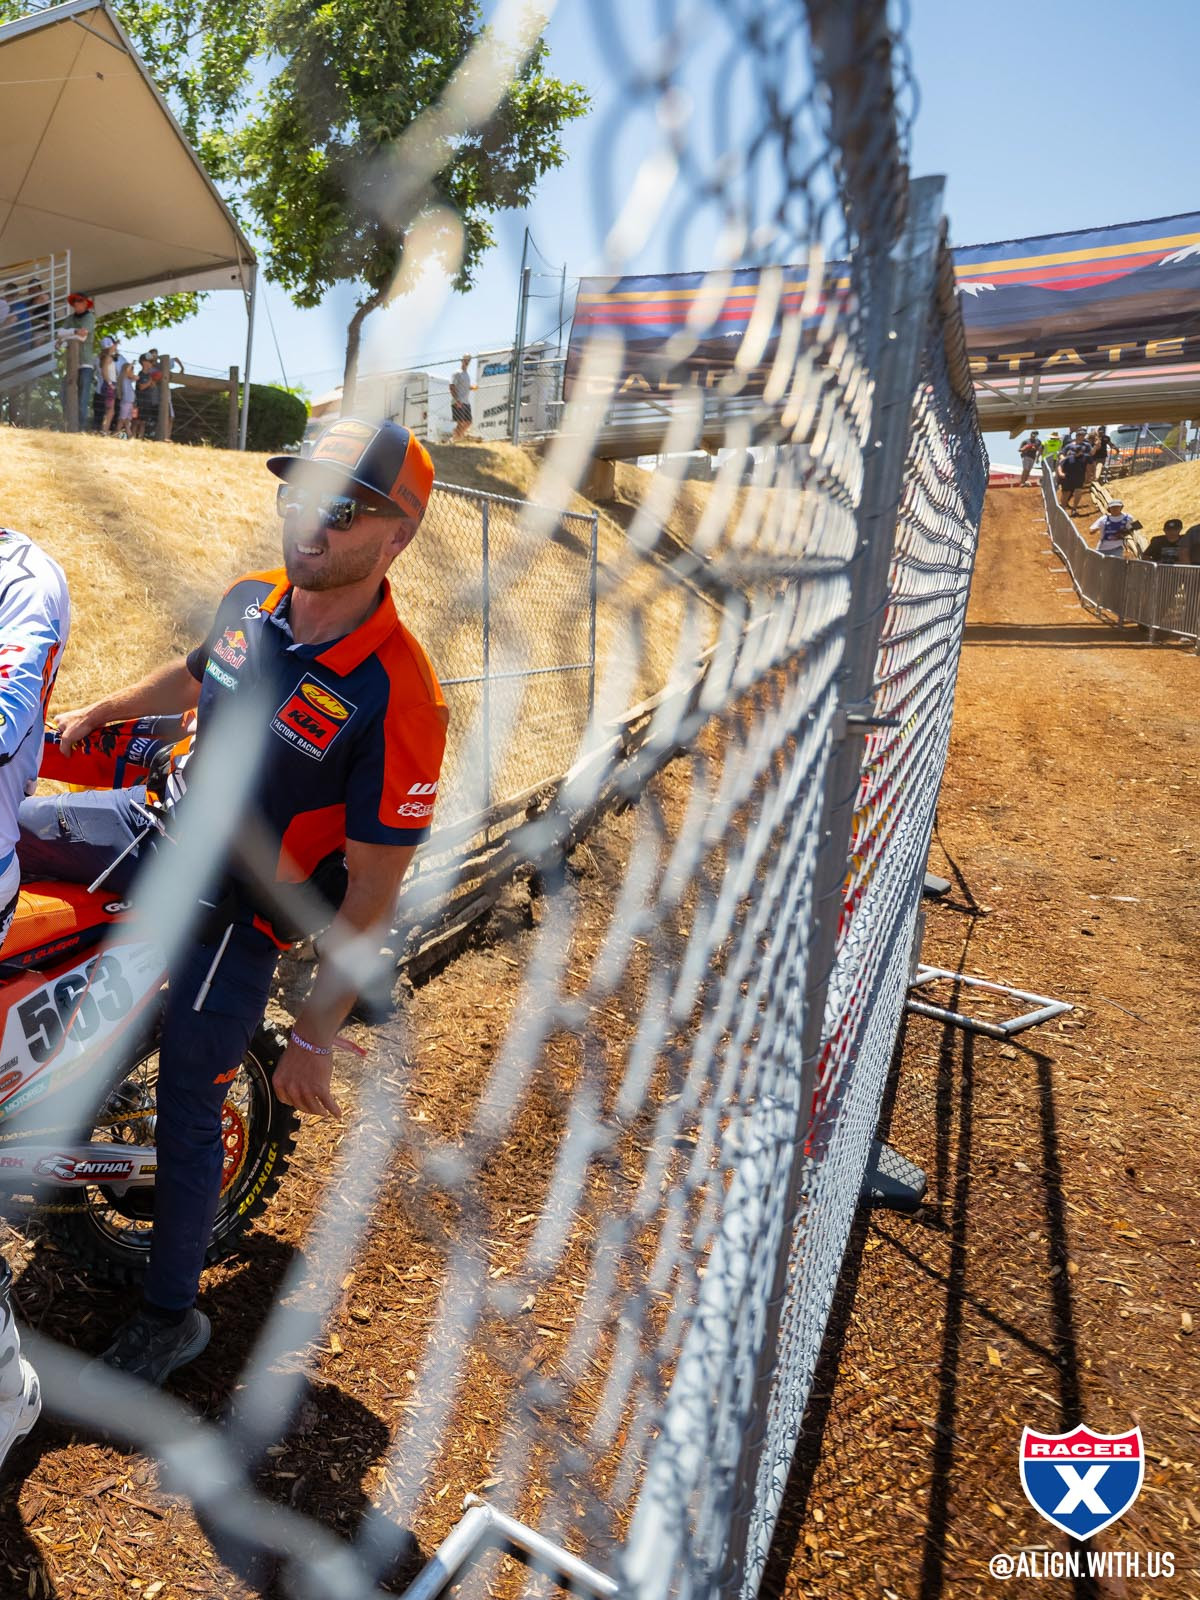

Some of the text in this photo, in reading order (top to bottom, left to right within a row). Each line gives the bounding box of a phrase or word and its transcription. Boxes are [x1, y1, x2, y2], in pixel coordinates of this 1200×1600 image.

[225, 646, 247, 670] Bull
[208, 661, 239, 691] MOTOREX
[302, 684, 349, 717] FMF
[273, 719, 322, 758] FACTORY RACING
[288, 709, 327, 739] KTM
[17, 955, 134, 1064] 563
[238, 1148, 277, 1216] DUNLOP
